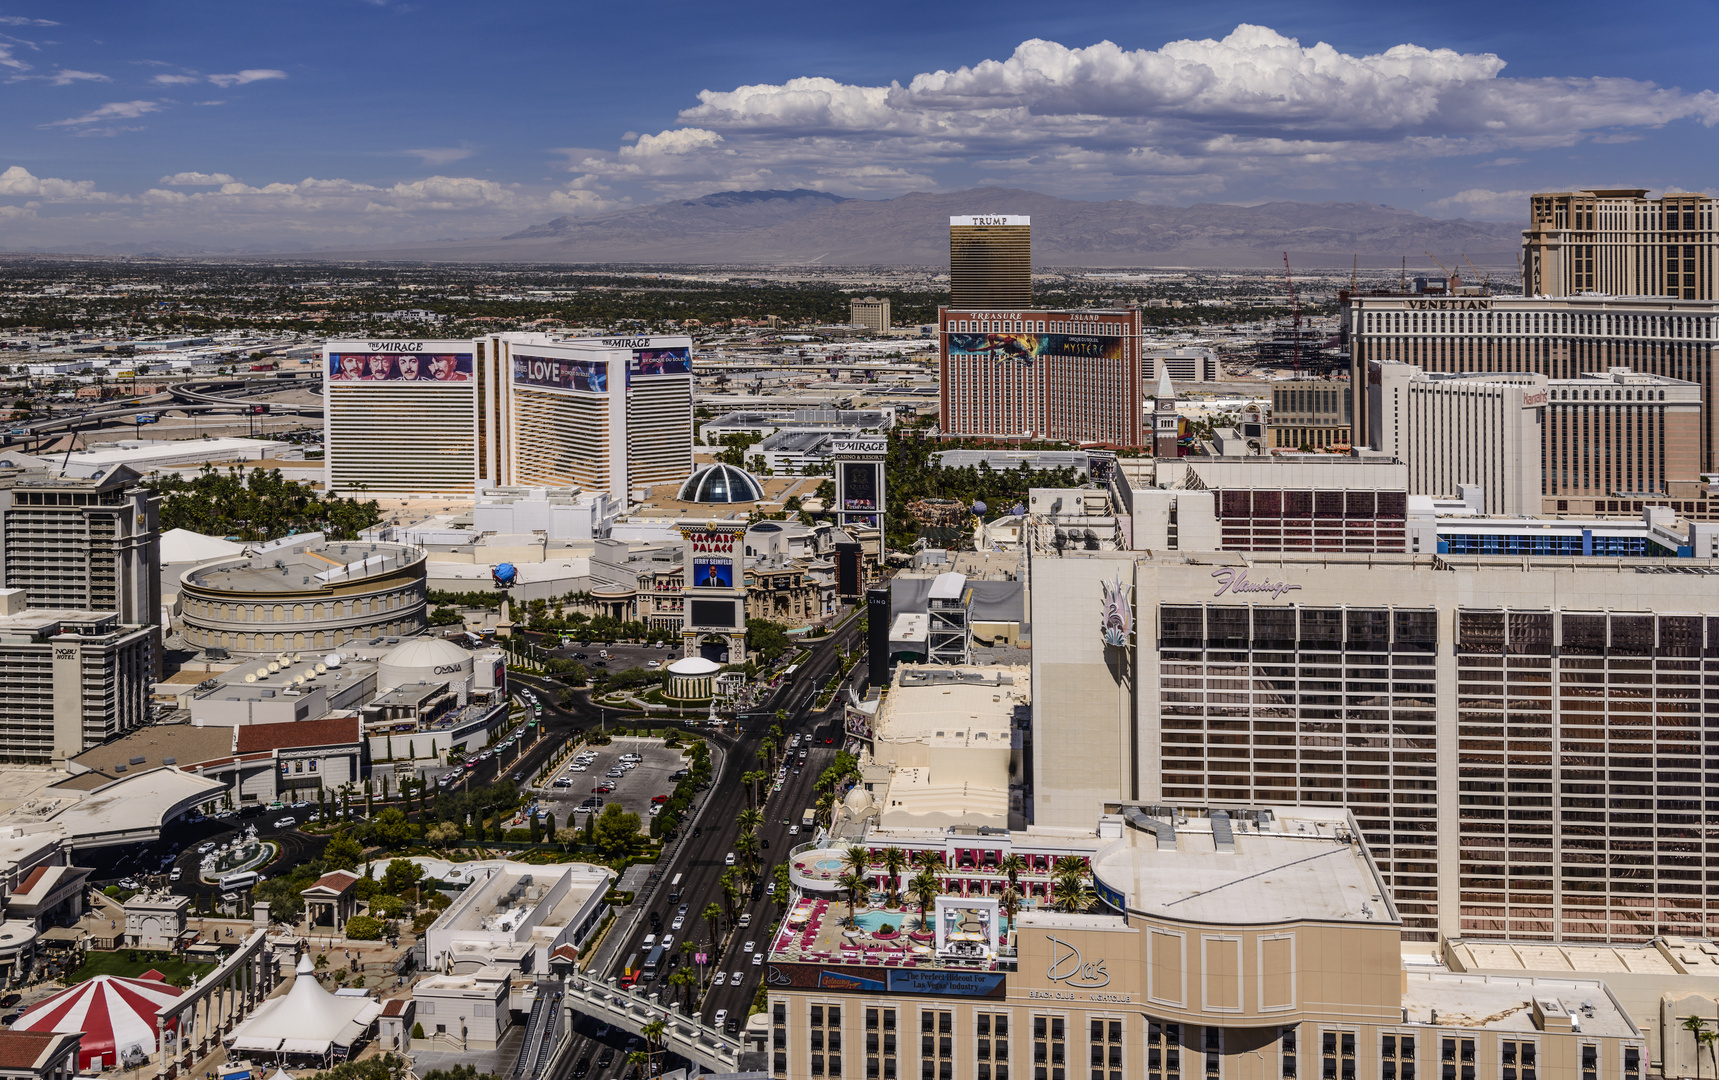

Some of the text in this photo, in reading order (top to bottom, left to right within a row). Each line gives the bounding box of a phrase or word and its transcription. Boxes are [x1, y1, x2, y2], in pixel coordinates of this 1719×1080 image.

[972, 217, 1007, 226] TRUMP
[1408, 300, 1488, 309] VENETIAN
[970, 312, 1023, 321] TREASURE
[372, 342, 423, 352] MIRAGE
[611, 338, 650, 348] MIRAGE
[528, 360, 560, 382] LOVE
[838, 442, 885, 452] MIRAGE
[690, 533, 736, 543] CAESARS
[693, 543, 733, 553] PALACE
[709, 558, 733, 566] SEINFELD
[1211, 567, 1302, 600] Flamingo
[1046, 934, 1111, 988] Drai's
[905, 971, 919, 980] The
[920, 972, 945, 981] Perfect
[946, 973, 973, 982] Hideout
[927, 981, 948, 990] Vegas'
[949, 982, 979, 992] Industry
[1029, 990, 1131, 1003] BEACH CLUB NIGHTCLUB
